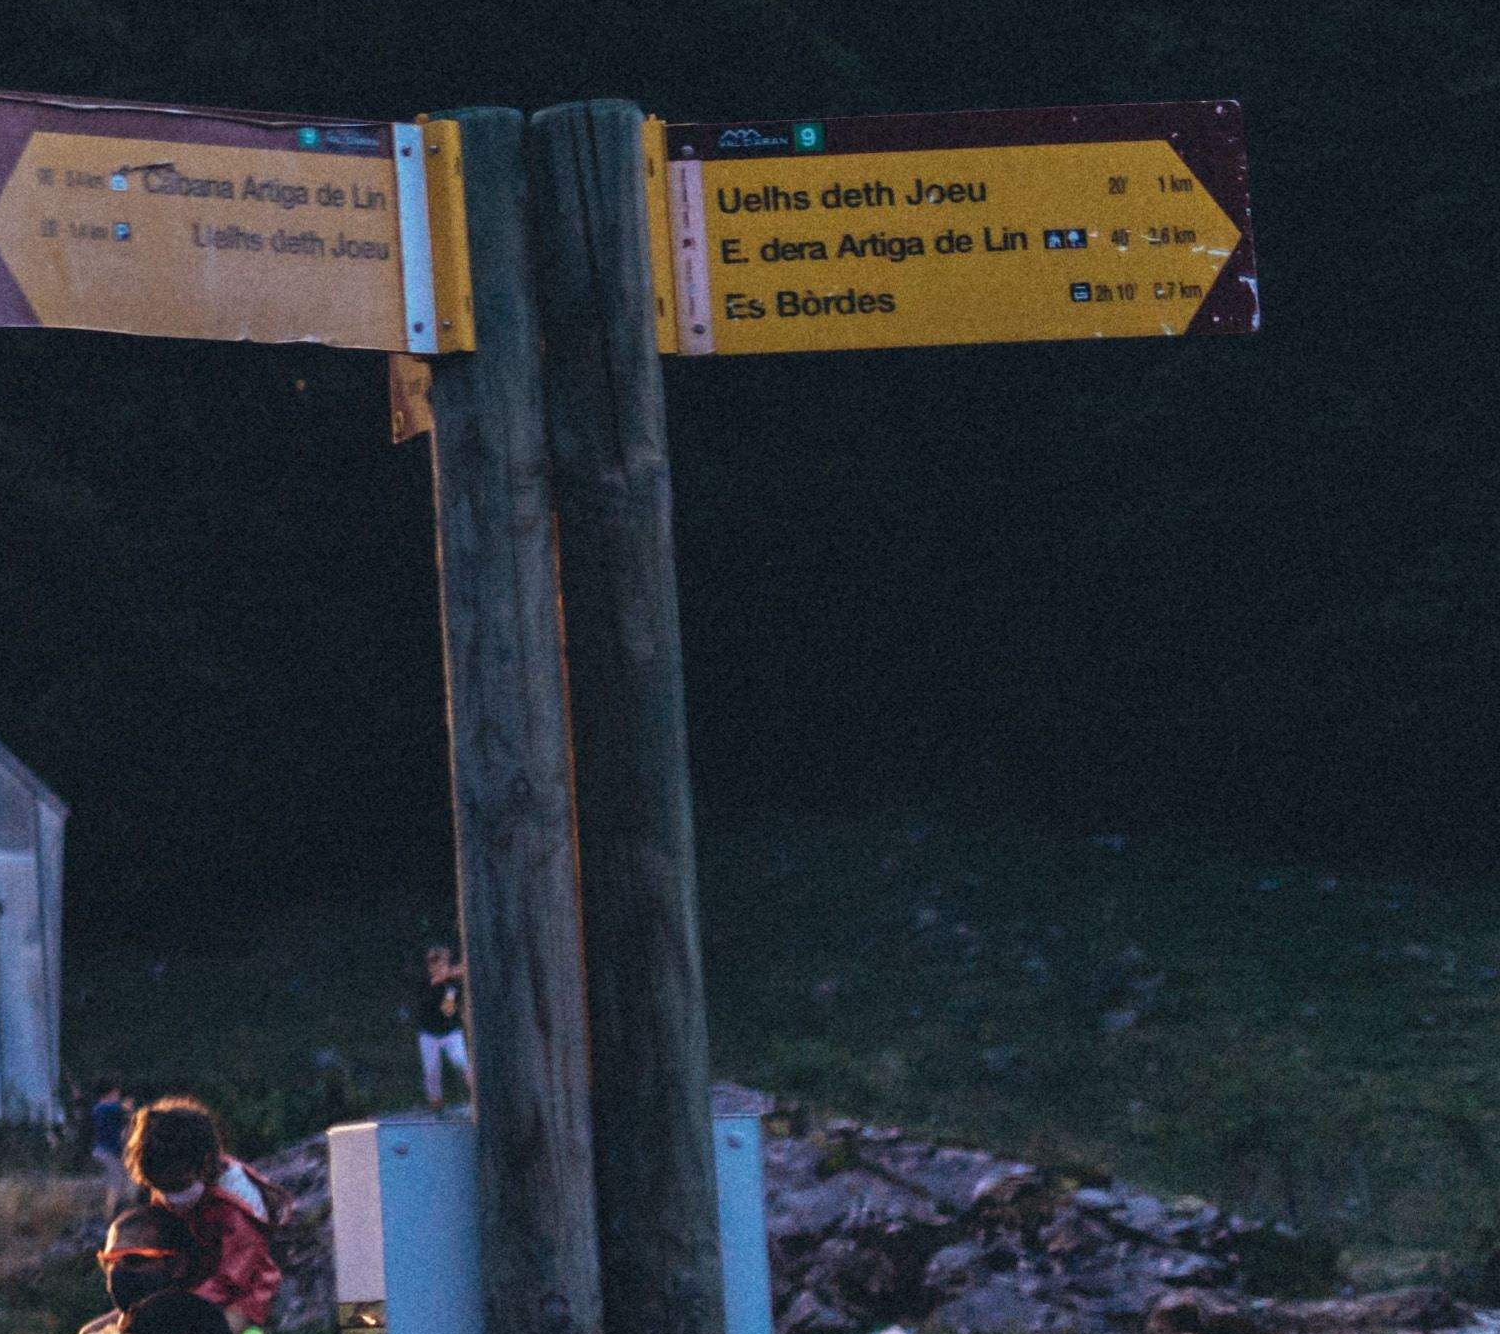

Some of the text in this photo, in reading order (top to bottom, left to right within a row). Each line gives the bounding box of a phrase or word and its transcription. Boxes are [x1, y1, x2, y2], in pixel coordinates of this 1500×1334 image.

[800, 126, 817, 148] 9
[241, 175, 309, 210] Artiga
[316, 183, 345, 208] de
[353, 183, 386, 211] Lin
[717, 185, 810, 213] Uelhs
[821, 181, 895, 208] deth
[906, 178, 987, 206] Joeu
[1171, 175, 1193, 192] km
[332, 232, 390, 261] Joeu
[721, 239, 749, 265] E.
[760, 236, 828, 262] dera
[838, 232, 925, 262] Artiga
[934, 228, 973, 254] de
[984, 225, 1028, 252] Lin
[725, 293, 766, 320] Es
[777, 288, 896, 318] Bòrdes
